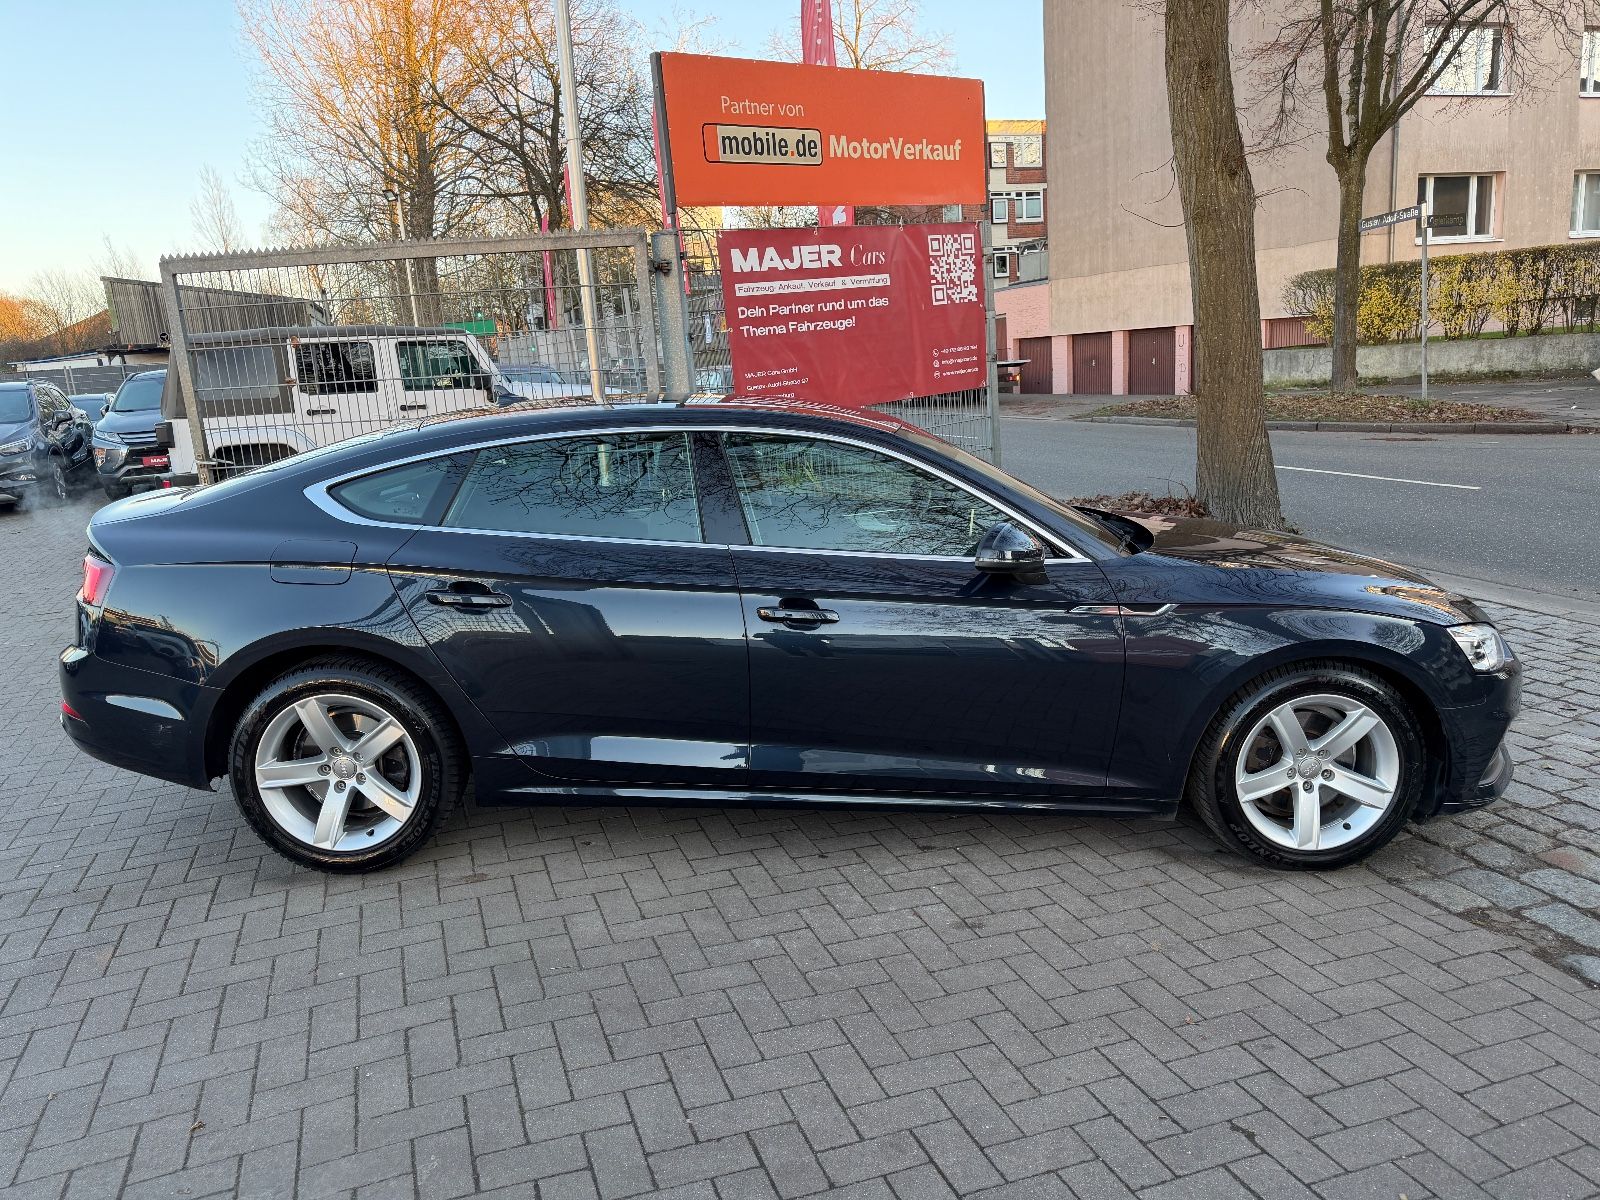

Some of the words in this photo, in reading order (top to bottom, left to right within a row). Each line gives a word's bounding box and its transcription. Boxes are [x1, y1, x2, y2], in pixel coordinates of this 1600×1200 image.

[720, 95, 774, 116] Partner
[777, 103, 805, 117] von
[721, 131, 818, 158] mobile.de
[828, 134, 962, 161] MotorVerkauf
[1361, 208, 1419, 229] GusavAdolf-Straße
[730, 244, 843, 273] MAJER
[850, 243, 886, 267] Cars
[808, 279, 836, 288] Verkauf
[738, 305, 767, 319] Dein
[769, 301, 815, 316] Partner
[817, 299, 845, 312] rund
[847, 299, 867, 309] um
[869, 296, 890, 307] das
[740, 325, 786, 338] Thema
[788, 316, 856, 333] Fahrzeuge!
[780, 366, 798, 374] GmbH
